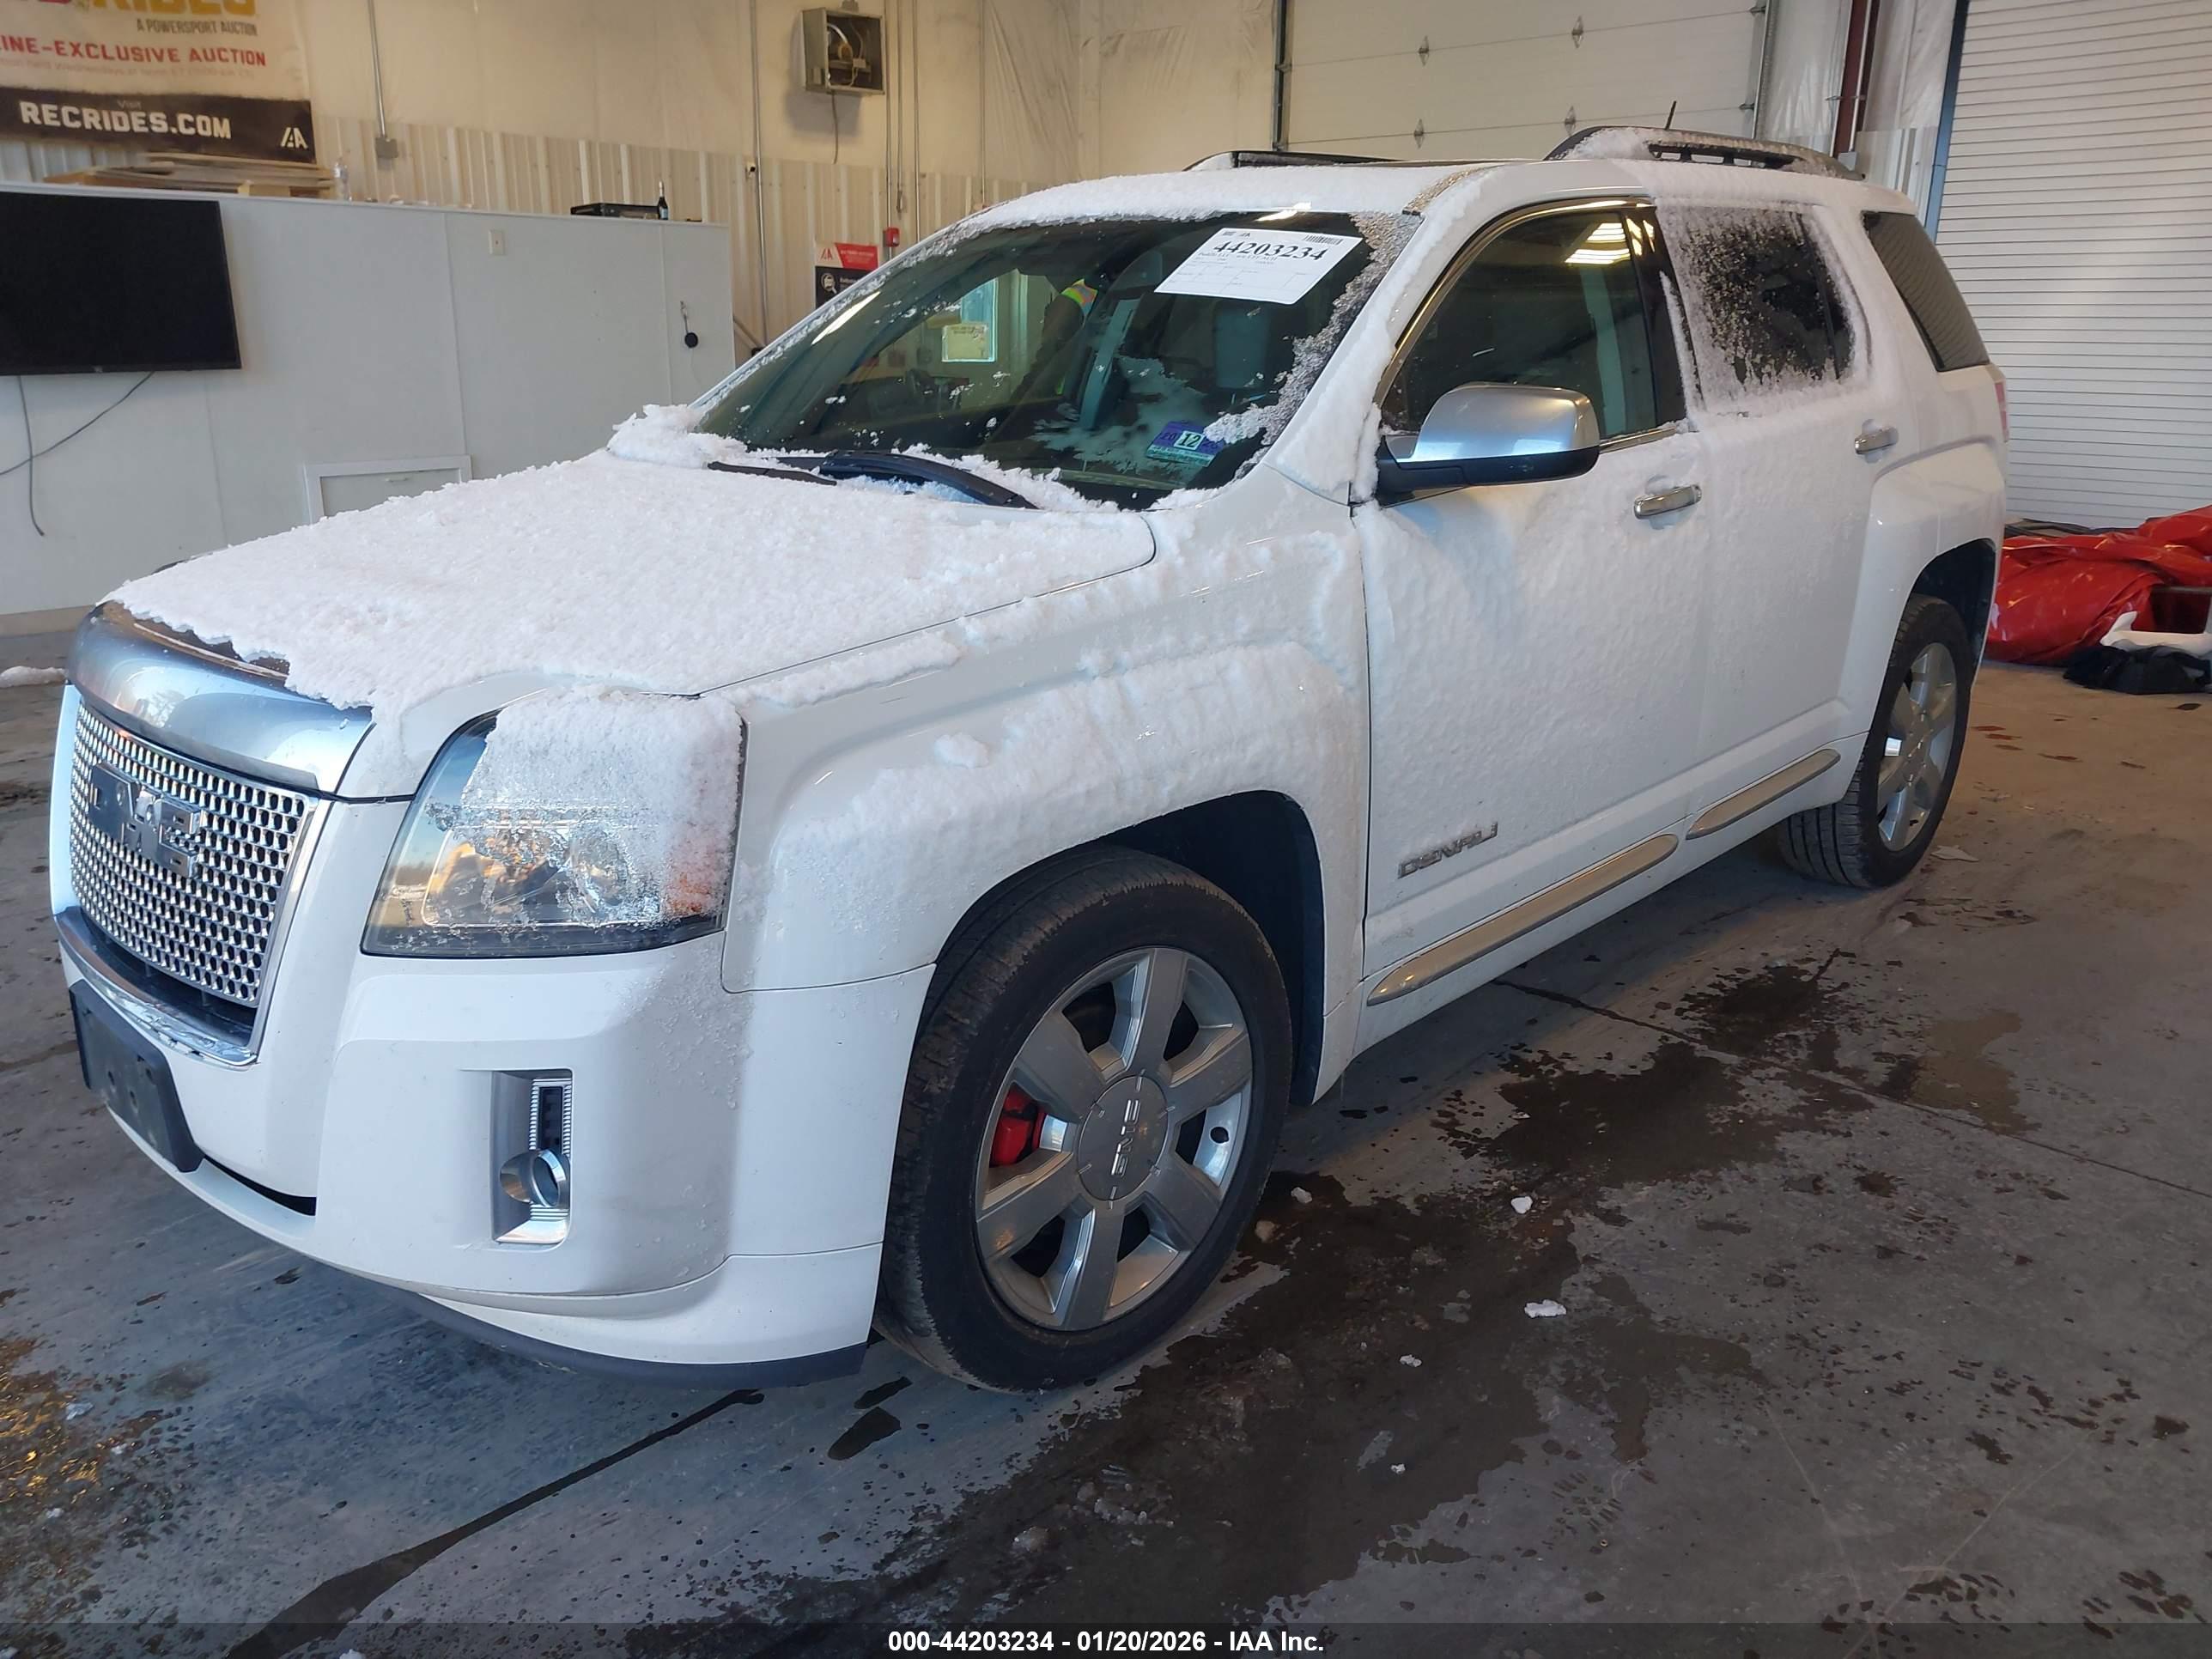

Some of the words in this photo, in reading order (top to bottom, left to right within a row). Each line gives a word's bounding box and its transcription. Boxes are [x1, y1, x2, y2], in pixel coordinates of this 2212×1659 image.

[147, 20, 216, 34] POWERSPORT
[221, 21, 258, 36] AUCTION
[0, 35, 180, 63] INE-EXCLUSIVE
[189, 47, 266, 66] AUCTION
[19, 100, 232, 139] RECRIDES.COM
[1213, 240, 1328, 261] 44203234
[1180, 433, 1201, 447] 12
